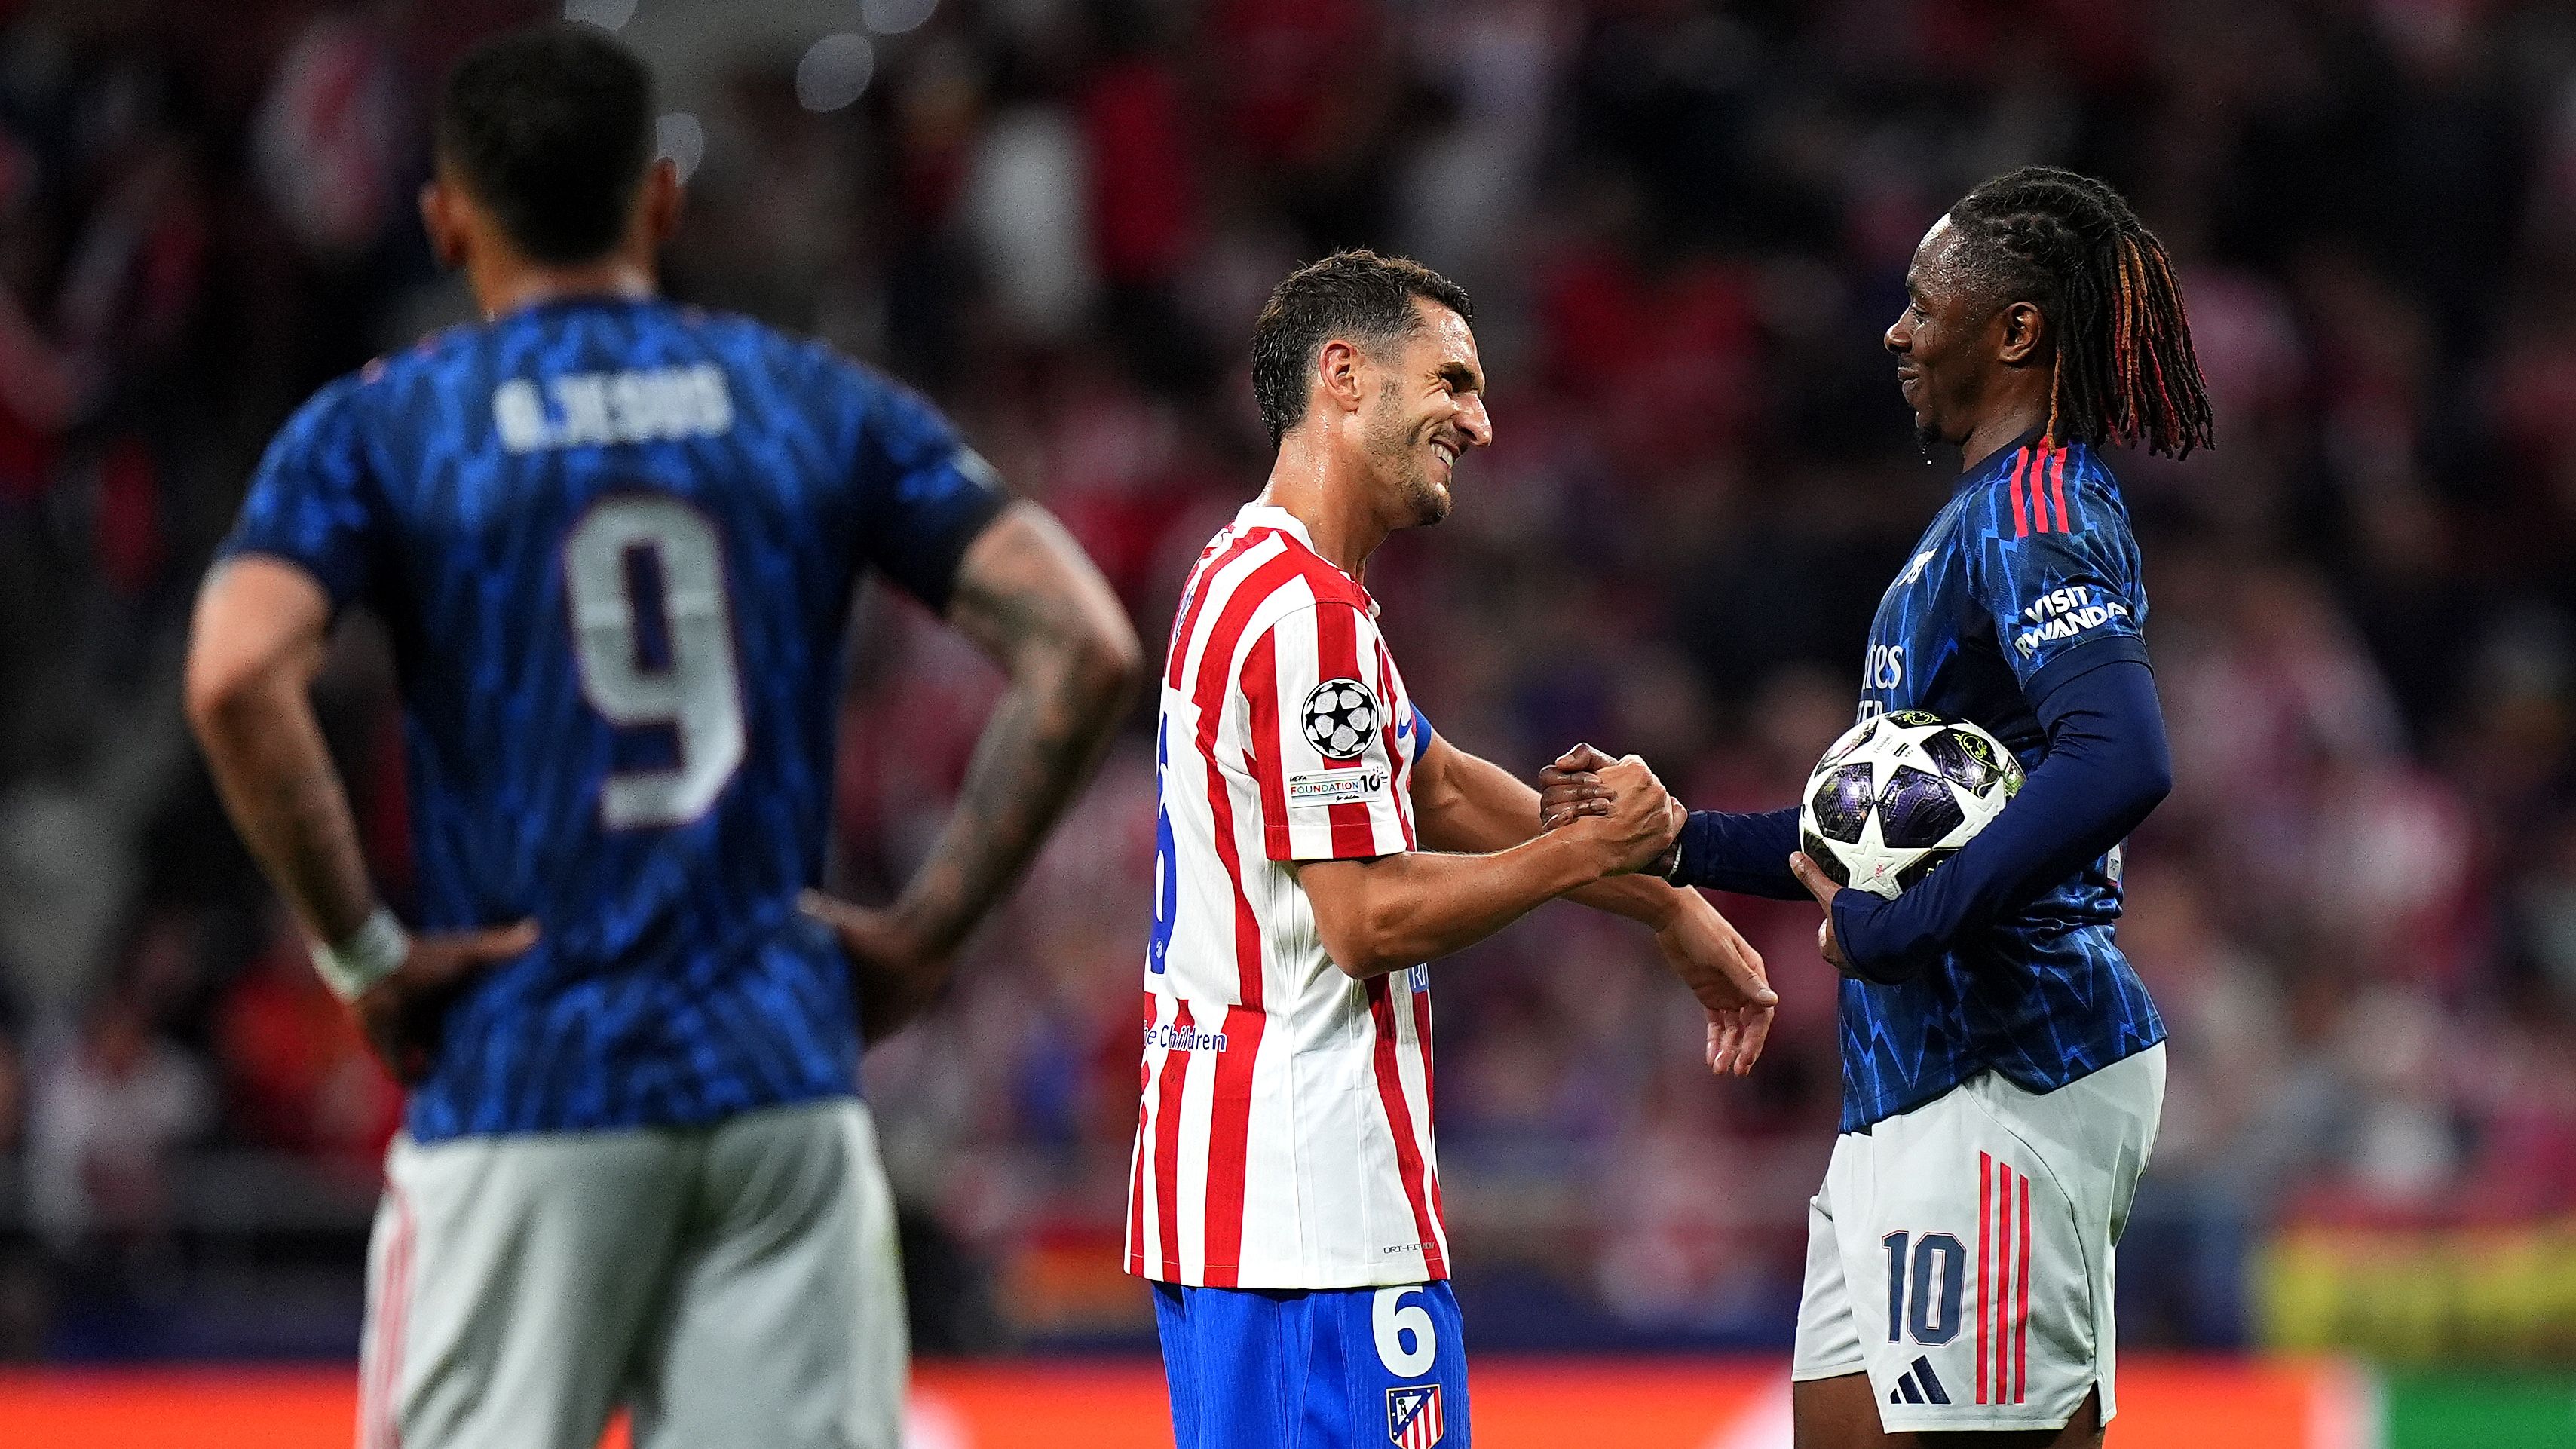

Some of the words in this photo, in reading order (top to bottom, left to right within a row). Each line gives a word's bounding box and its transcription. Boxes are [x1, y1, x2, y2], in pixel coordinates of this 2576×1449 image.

[2014, 602, 2127, 660] RWANDA
[2025, 586, 2088, 623] VISIT
[564, 493, 743, 828] 9
[1290, 782, 1359, 795] FOUNDATION
[1360, 774, 1380, 792] 10
[1160, 1025, 1226, 1050] Children
[1882, 1230, 1966, 1346] 10
[1372, 1283, 1436, 1377] 6
